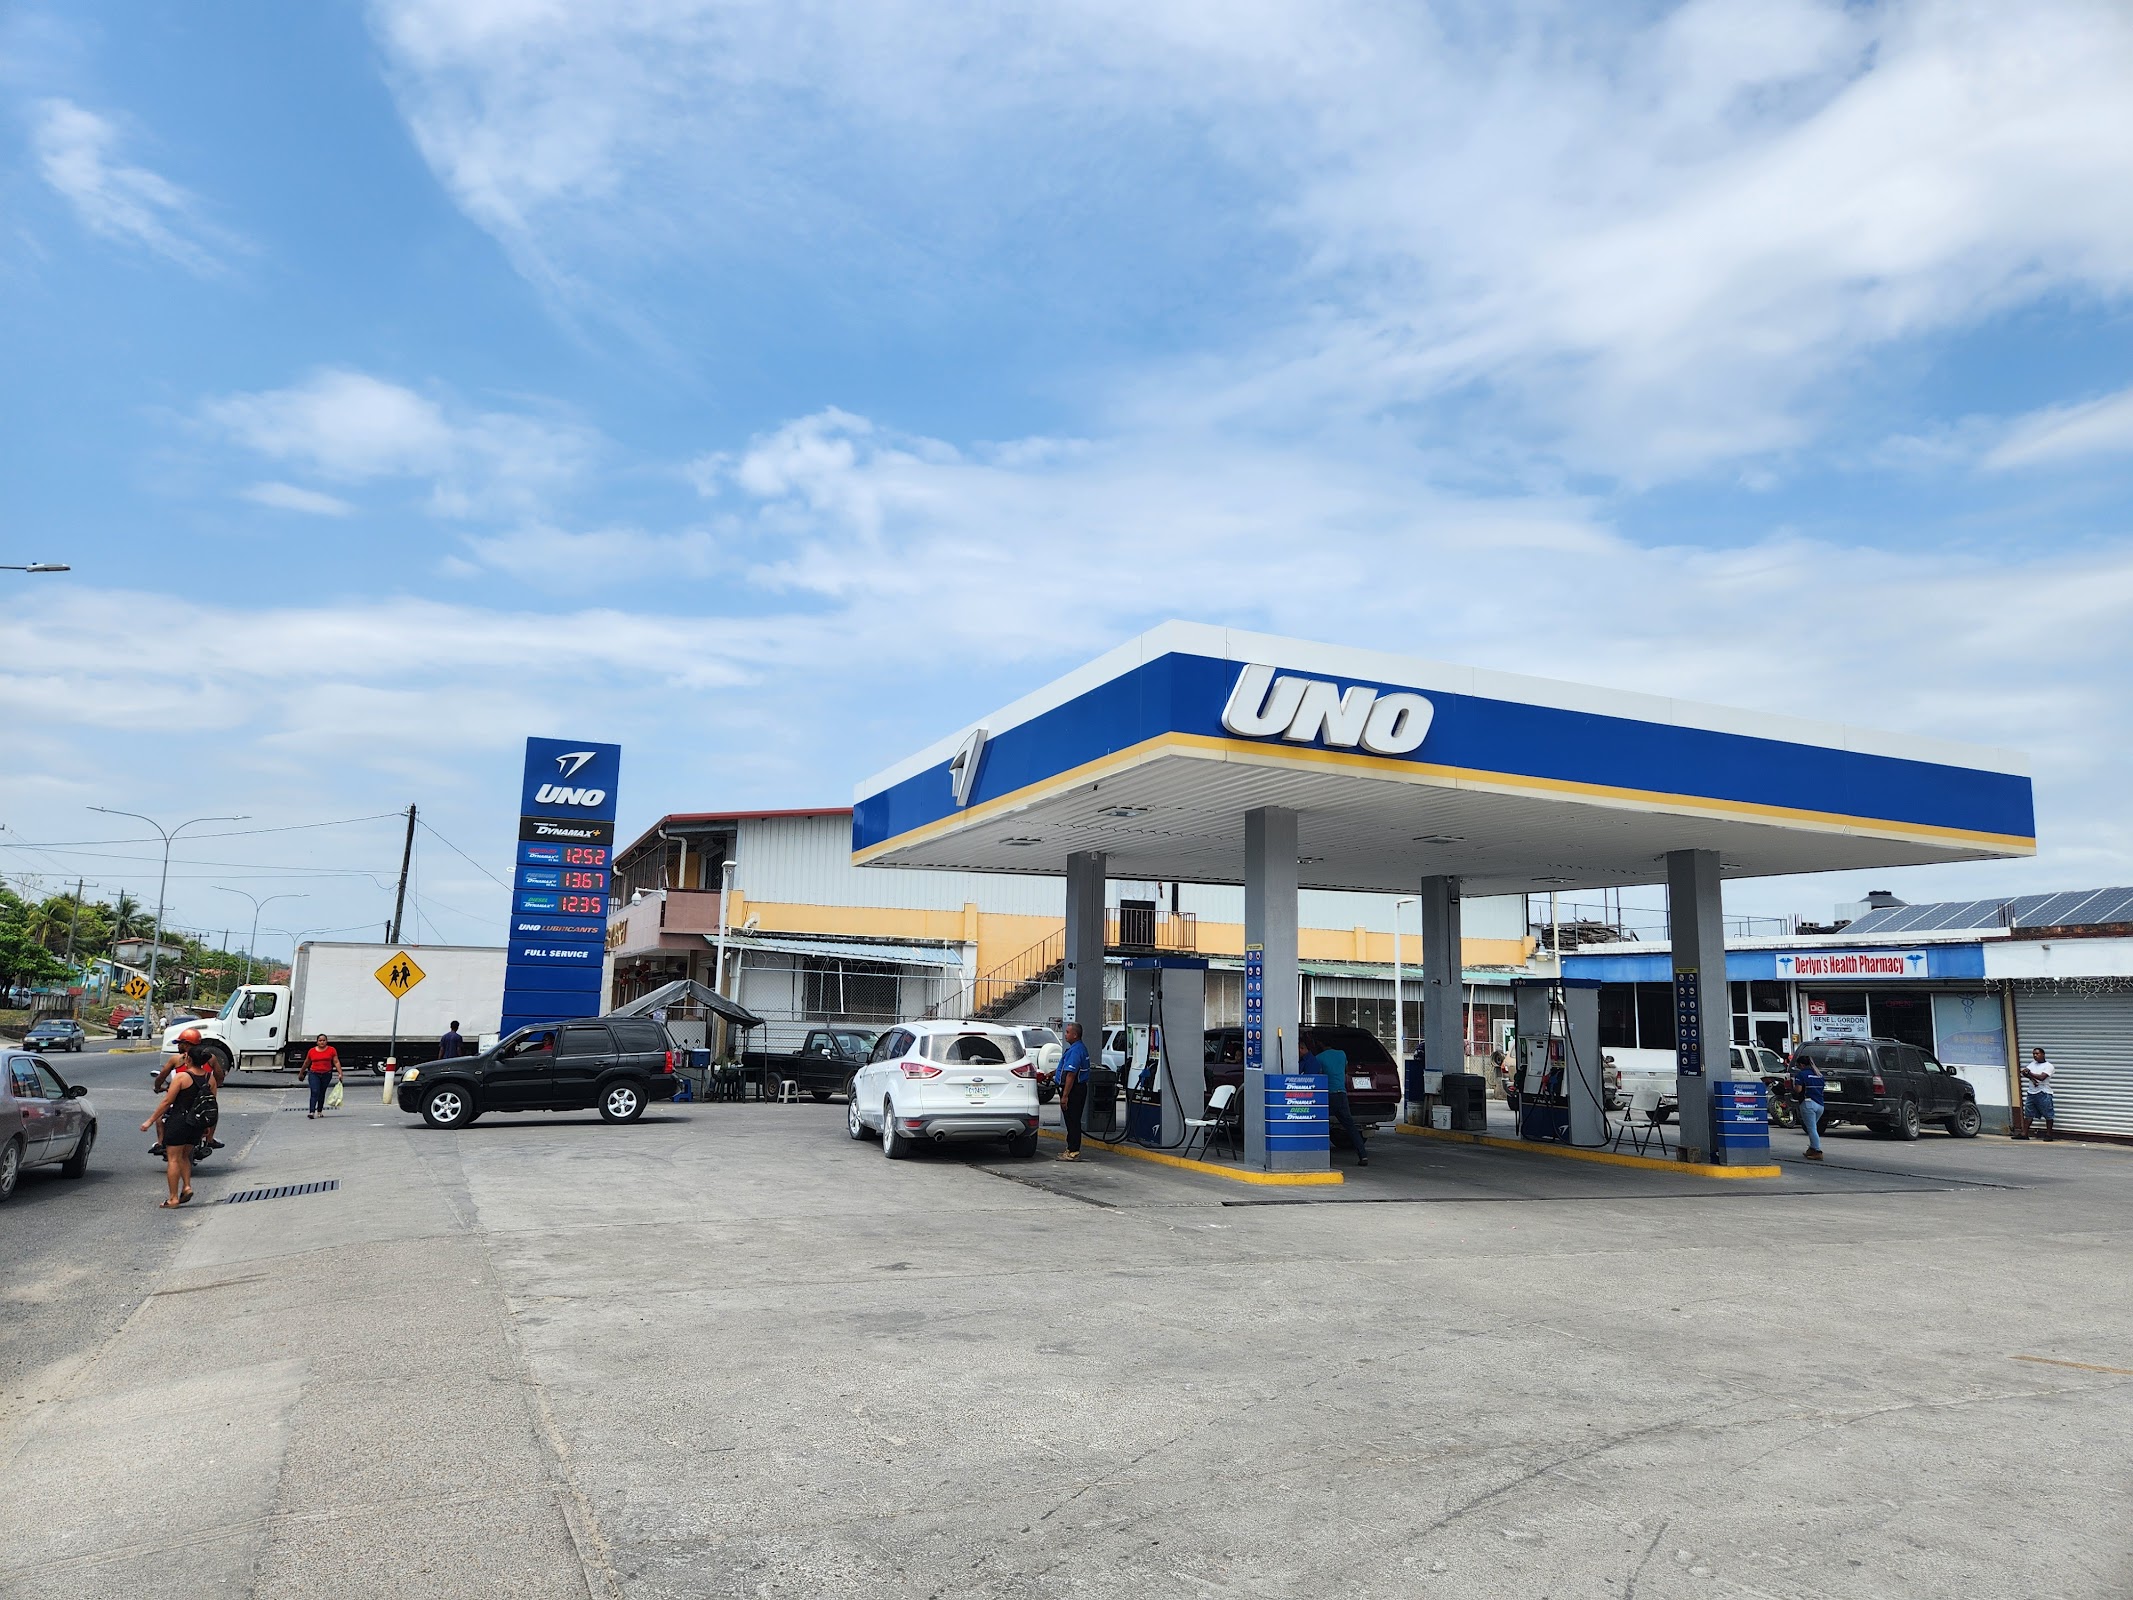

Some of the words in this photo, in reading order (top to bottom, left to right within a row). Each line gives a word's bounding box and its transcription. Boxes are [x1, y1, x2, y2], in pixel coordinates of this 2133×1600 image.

[1221, 663, 1434, 754] UNO
[535, 783, 606, 807] UNO
[518, 923, 541, 931] UNO
[524, 949, 547, 957] FULL
[549, 950, 589, 958] SERVICE
[1795, 956, 1828, 975] Derlyn's
[1829, 955, 1858, 973] Health
[1859, 955, 1904, 974] Pharmacy
[1943, 1043, 1975, 1053] Opening
[1977, 1045, 2001, 1053] Hours
